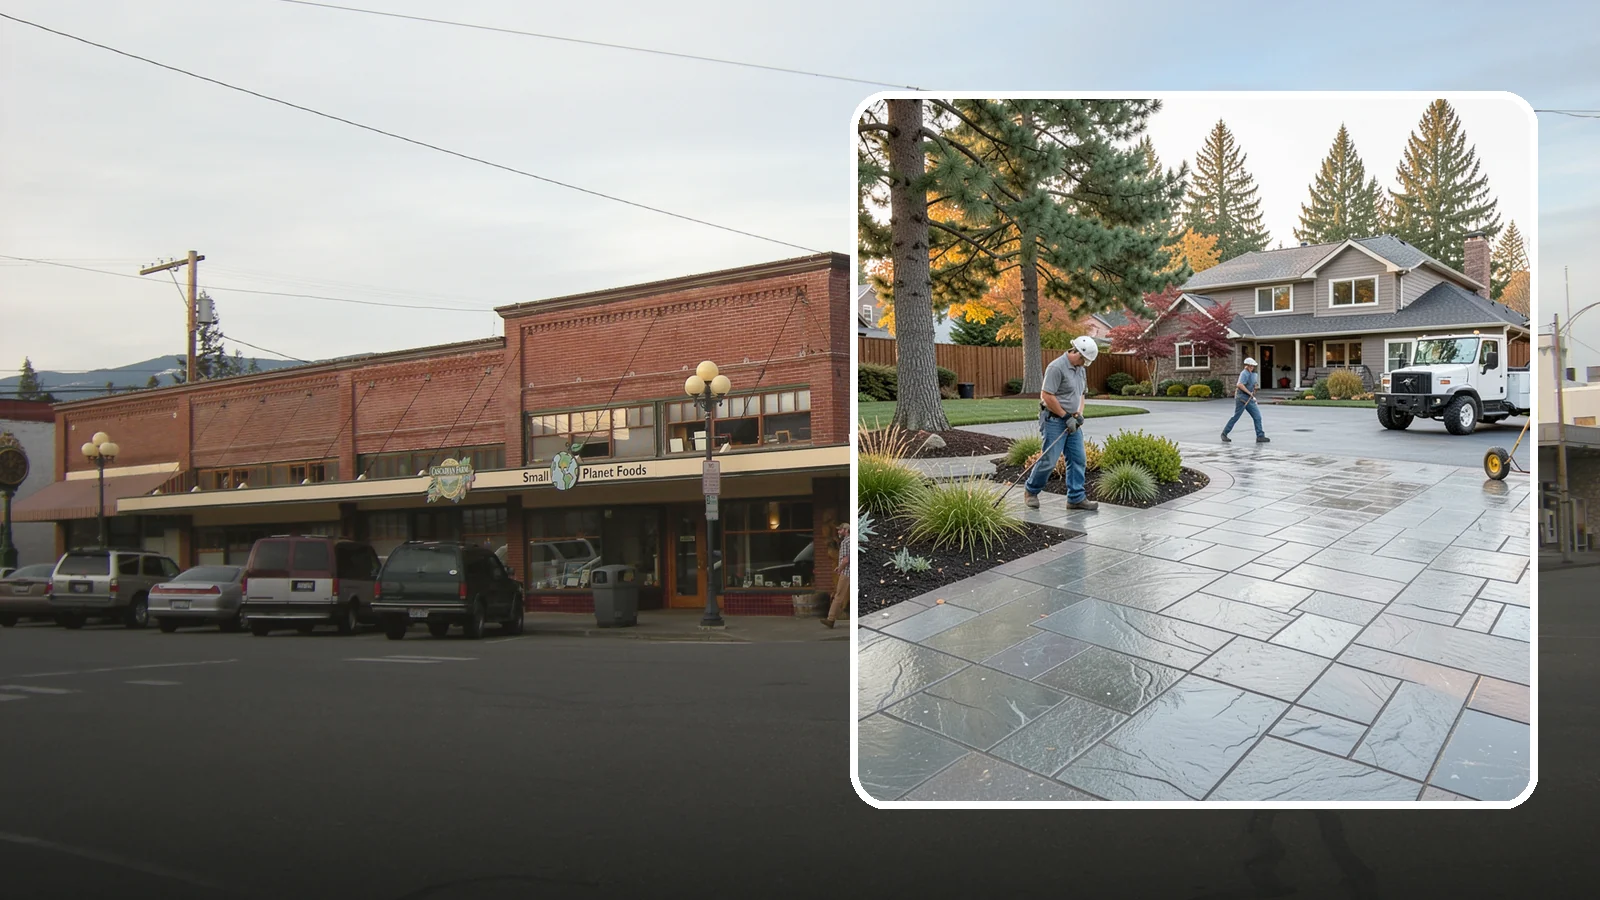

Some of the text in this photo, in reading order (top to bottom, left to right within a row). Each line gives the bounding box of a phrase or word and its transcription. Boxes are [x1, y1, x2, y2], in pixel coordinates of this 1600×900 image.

[431, 467, 455, 476] CASCADIAN
[523, 464, 647, 483] Small Planet Foods
